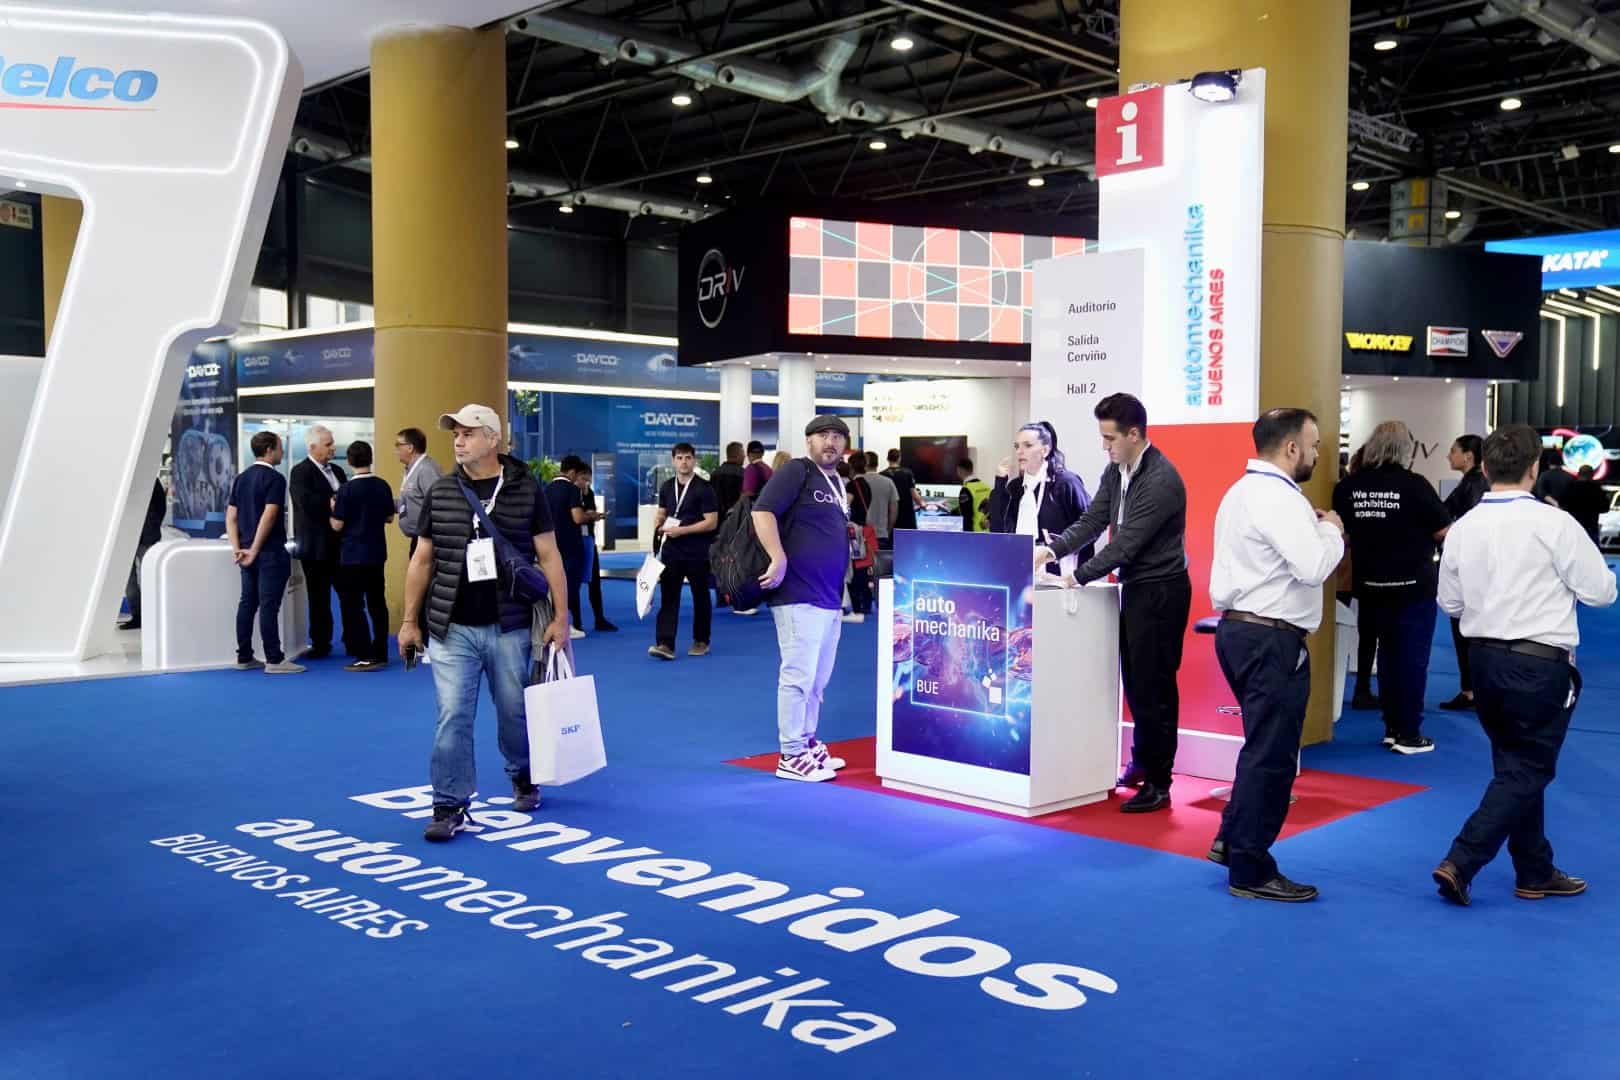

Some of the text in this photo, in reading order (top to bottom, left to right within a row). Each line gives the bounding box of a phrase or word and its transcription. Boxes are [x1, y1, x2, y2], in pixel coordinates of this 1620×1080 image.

[0, 56, 159, 102] elco
[1115, 101, 1143, 166] i
[1068, 300, 1116, 314] Auditorio
[1184, 203, 1205, 407] automechanika
[1067, 334, 1100, 346] Salida
[1208, 267, 1225, 406] BUENOS AIRES
[576, 353, 617, 365] DAYCO
[1067, 350, 1107, 362] Cerviño
[1067, 382, 1097, 394] Hall 2
[643, 412, 698, 427] DAYCO
[1352, 490, 1400, 500] We create
[1353, 500, 1401, 510] exhibition
[1354, 511, 1387, 520] spaces
[915, 596, 956, 614] auto
[915, 618, 1001, 642] mechanika
[916, 680, 939, 695] BUE
[149, 833, 429, 938] BUENOS AIRES
[235, 818, 897, 1053] automechanika
